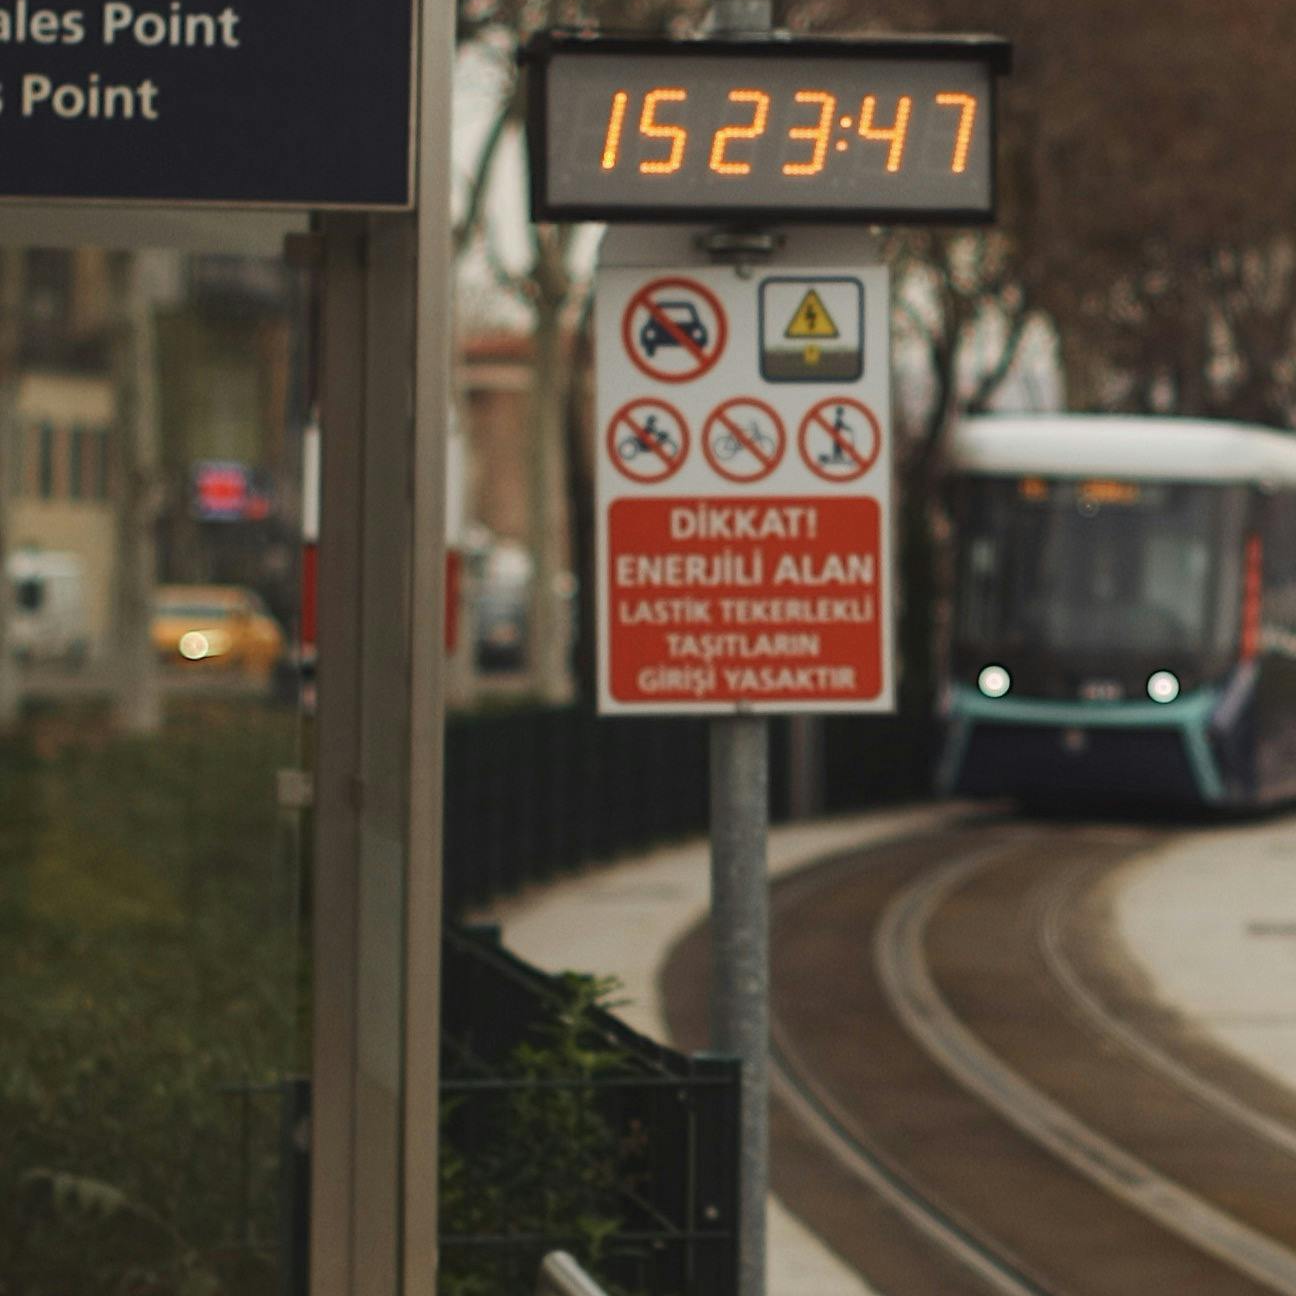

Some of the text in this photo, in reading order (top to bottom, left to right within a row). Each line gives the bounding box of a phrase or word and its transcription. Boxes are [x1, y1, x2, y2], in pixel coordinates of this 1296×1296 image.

[103, 2, 240, 48] Point
[22, 73, 158, 120] Point
[669, 504, 818, 540] DİKKAT!
[615, 551, 875, 586] ENERJİLİ ALAN
[618, 596, 712, 625] LASTİK
[665, 633, 821, 662] TAŞITLARIN
[723, 667, 856, 691] YASAKTIR
